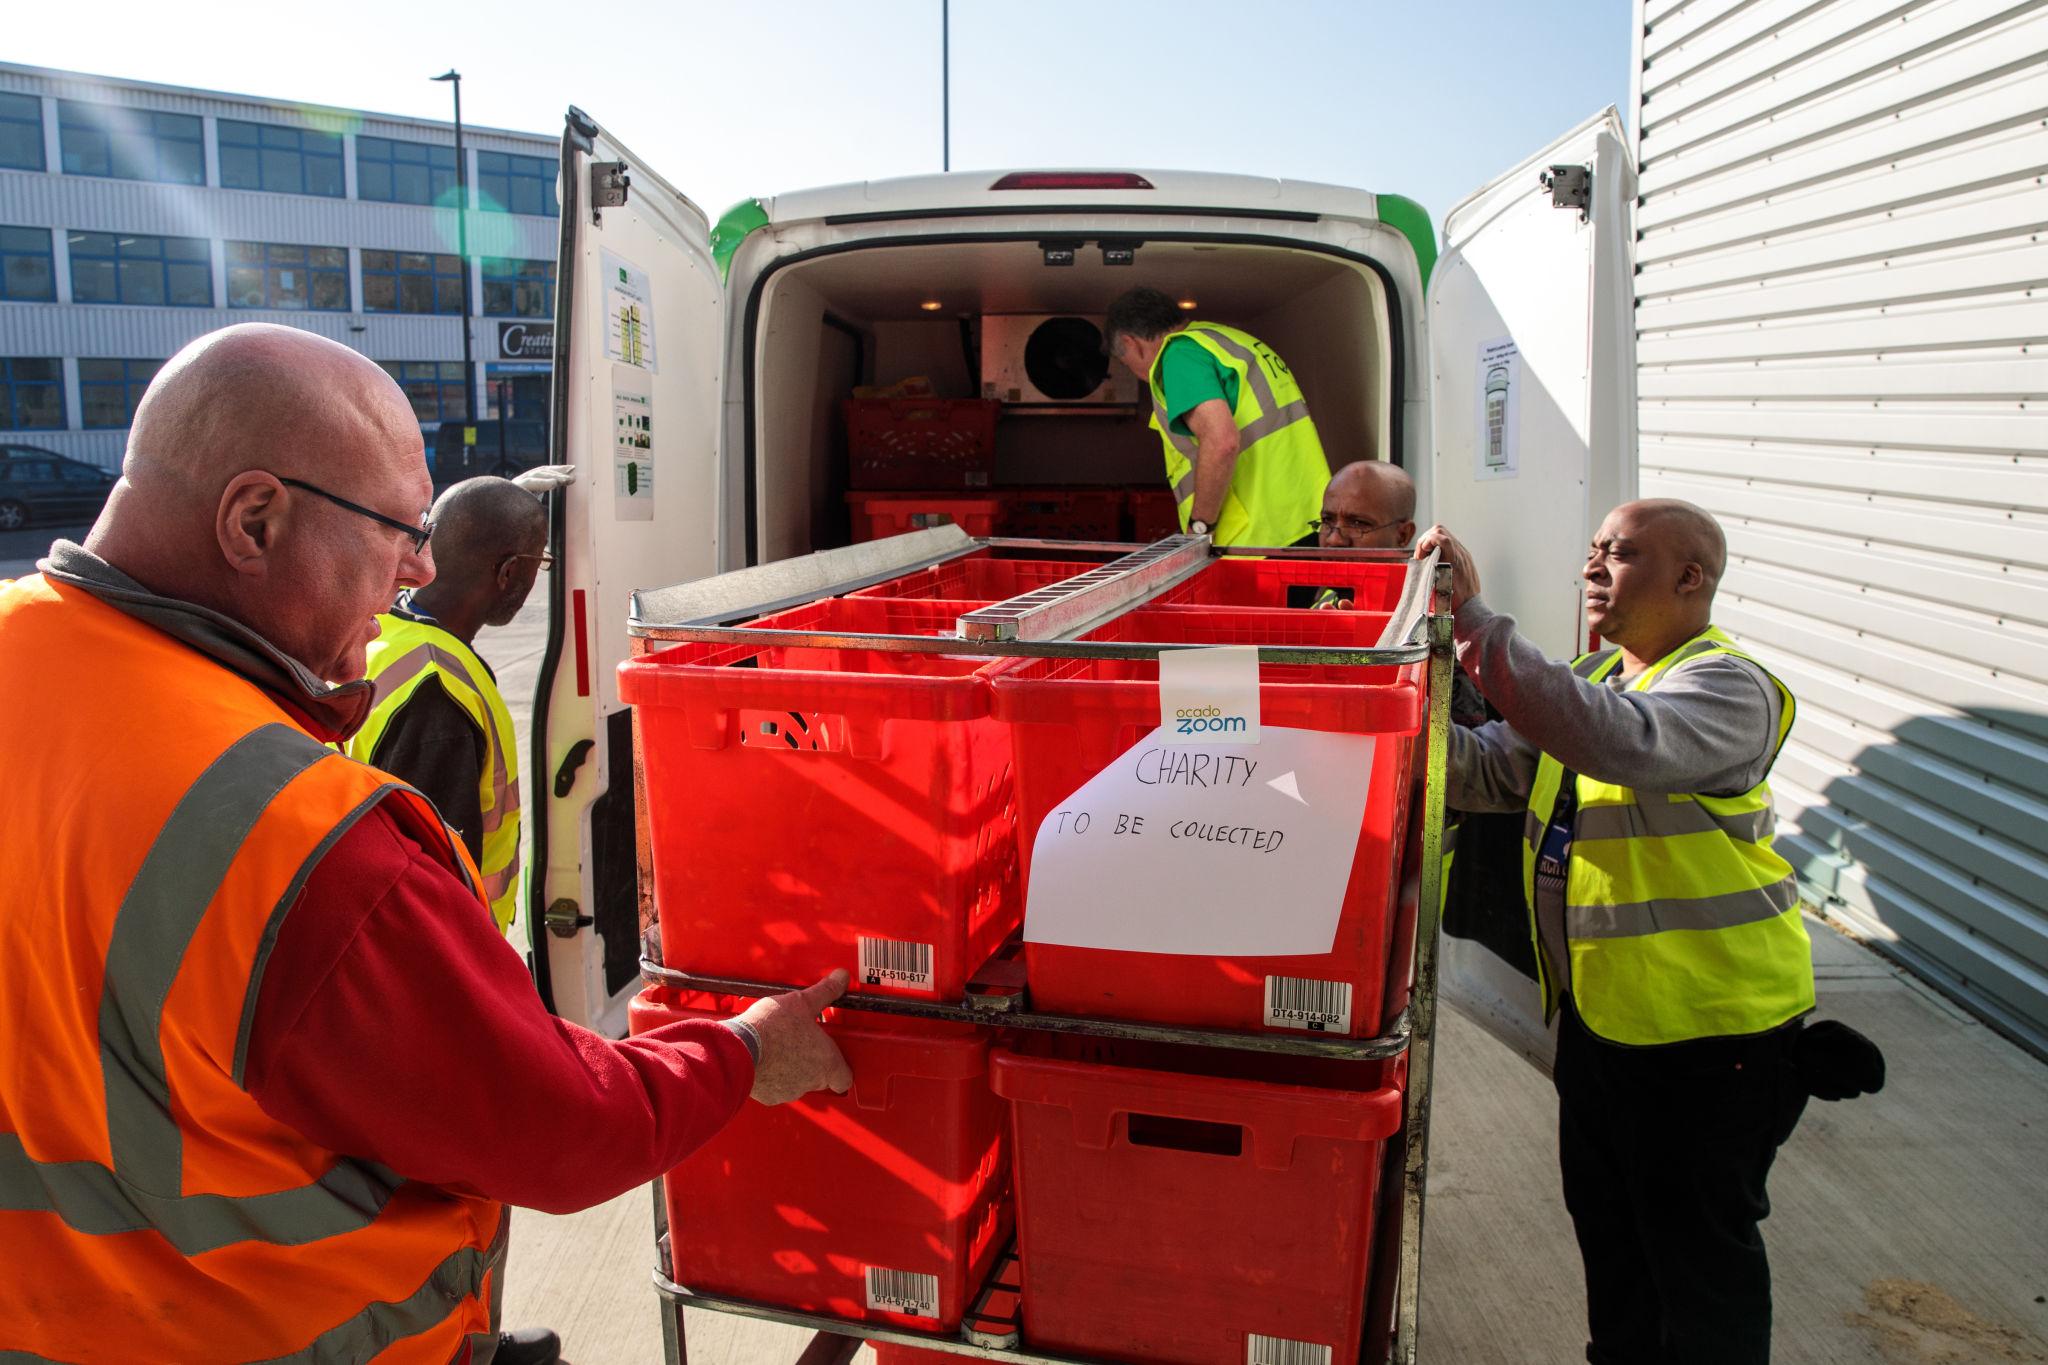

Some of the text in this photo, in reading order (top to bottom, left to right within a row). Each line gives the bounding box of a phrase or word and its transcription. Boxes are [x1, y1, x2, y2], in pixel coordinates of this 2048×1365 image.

[1176, 704, 1221, 718] ocado
[1135, 748, 1258, 789] CHARITY
[1058, 811, 1284, 853] TO BE COLLECTED
[868, 967, 926, 983] DT4-510-617
[1272, 1008, 1340, 1024] DT4-914-082
